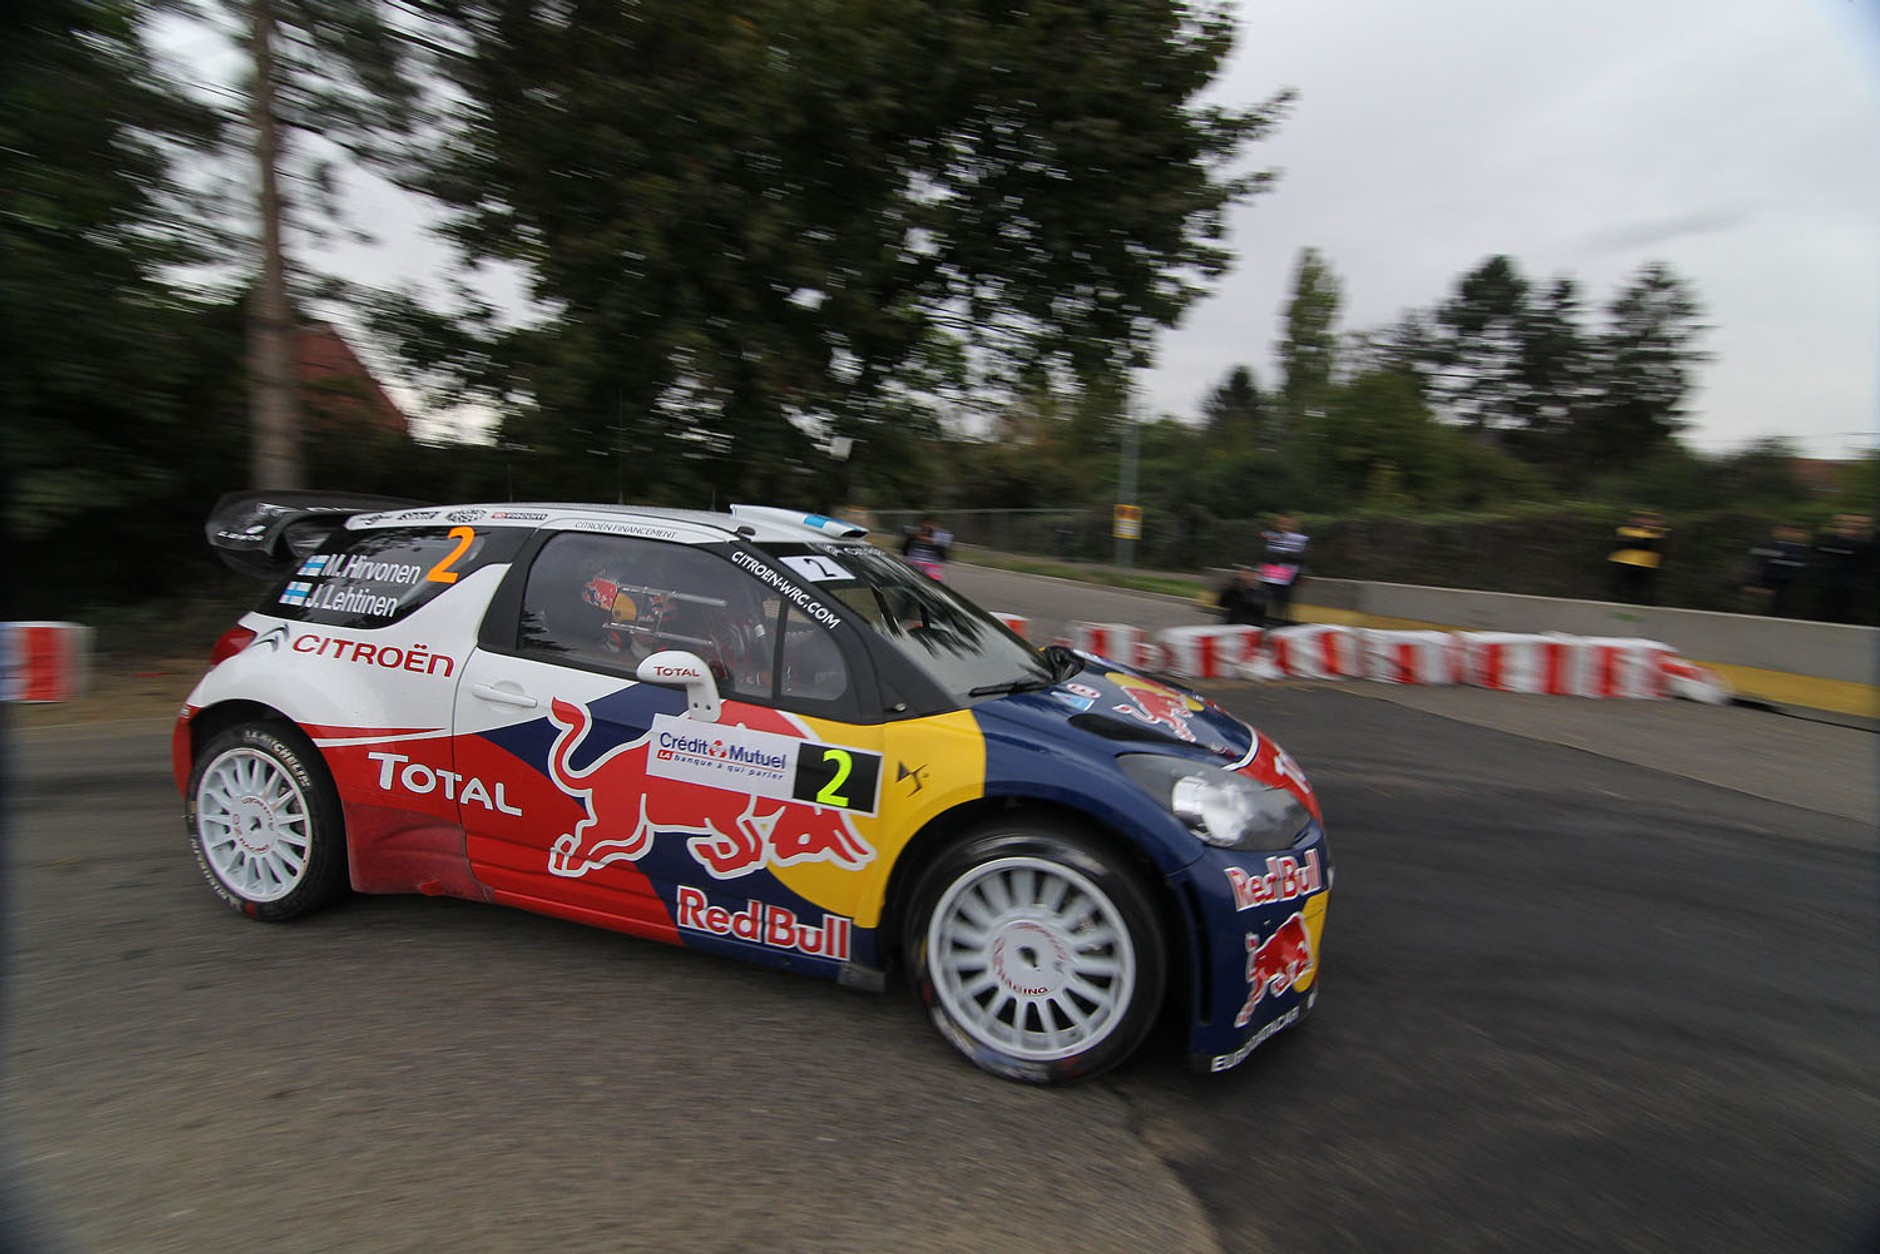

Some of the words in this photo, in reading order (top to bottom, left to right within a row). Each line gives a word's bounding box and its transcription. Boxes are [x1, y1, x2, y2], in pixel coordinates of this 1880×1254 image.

[613, 523, 678, 539] FINANCEMENT
[426, 526, 475, 584] 2
[293, 634, 455, 678] CITROËN
[653, 665, 701, 678] TOTAL
[659, 731, 709, 756] Crédit
[729, 744, 787, 770] Mutuel
[673, 754, 712, 768] banque
[727, 764, 745, 776] qui
[747, 768, 784, 780] parler
[367, 752, 523, 817] TOTAL
[815, 749, 853, 808] 2
